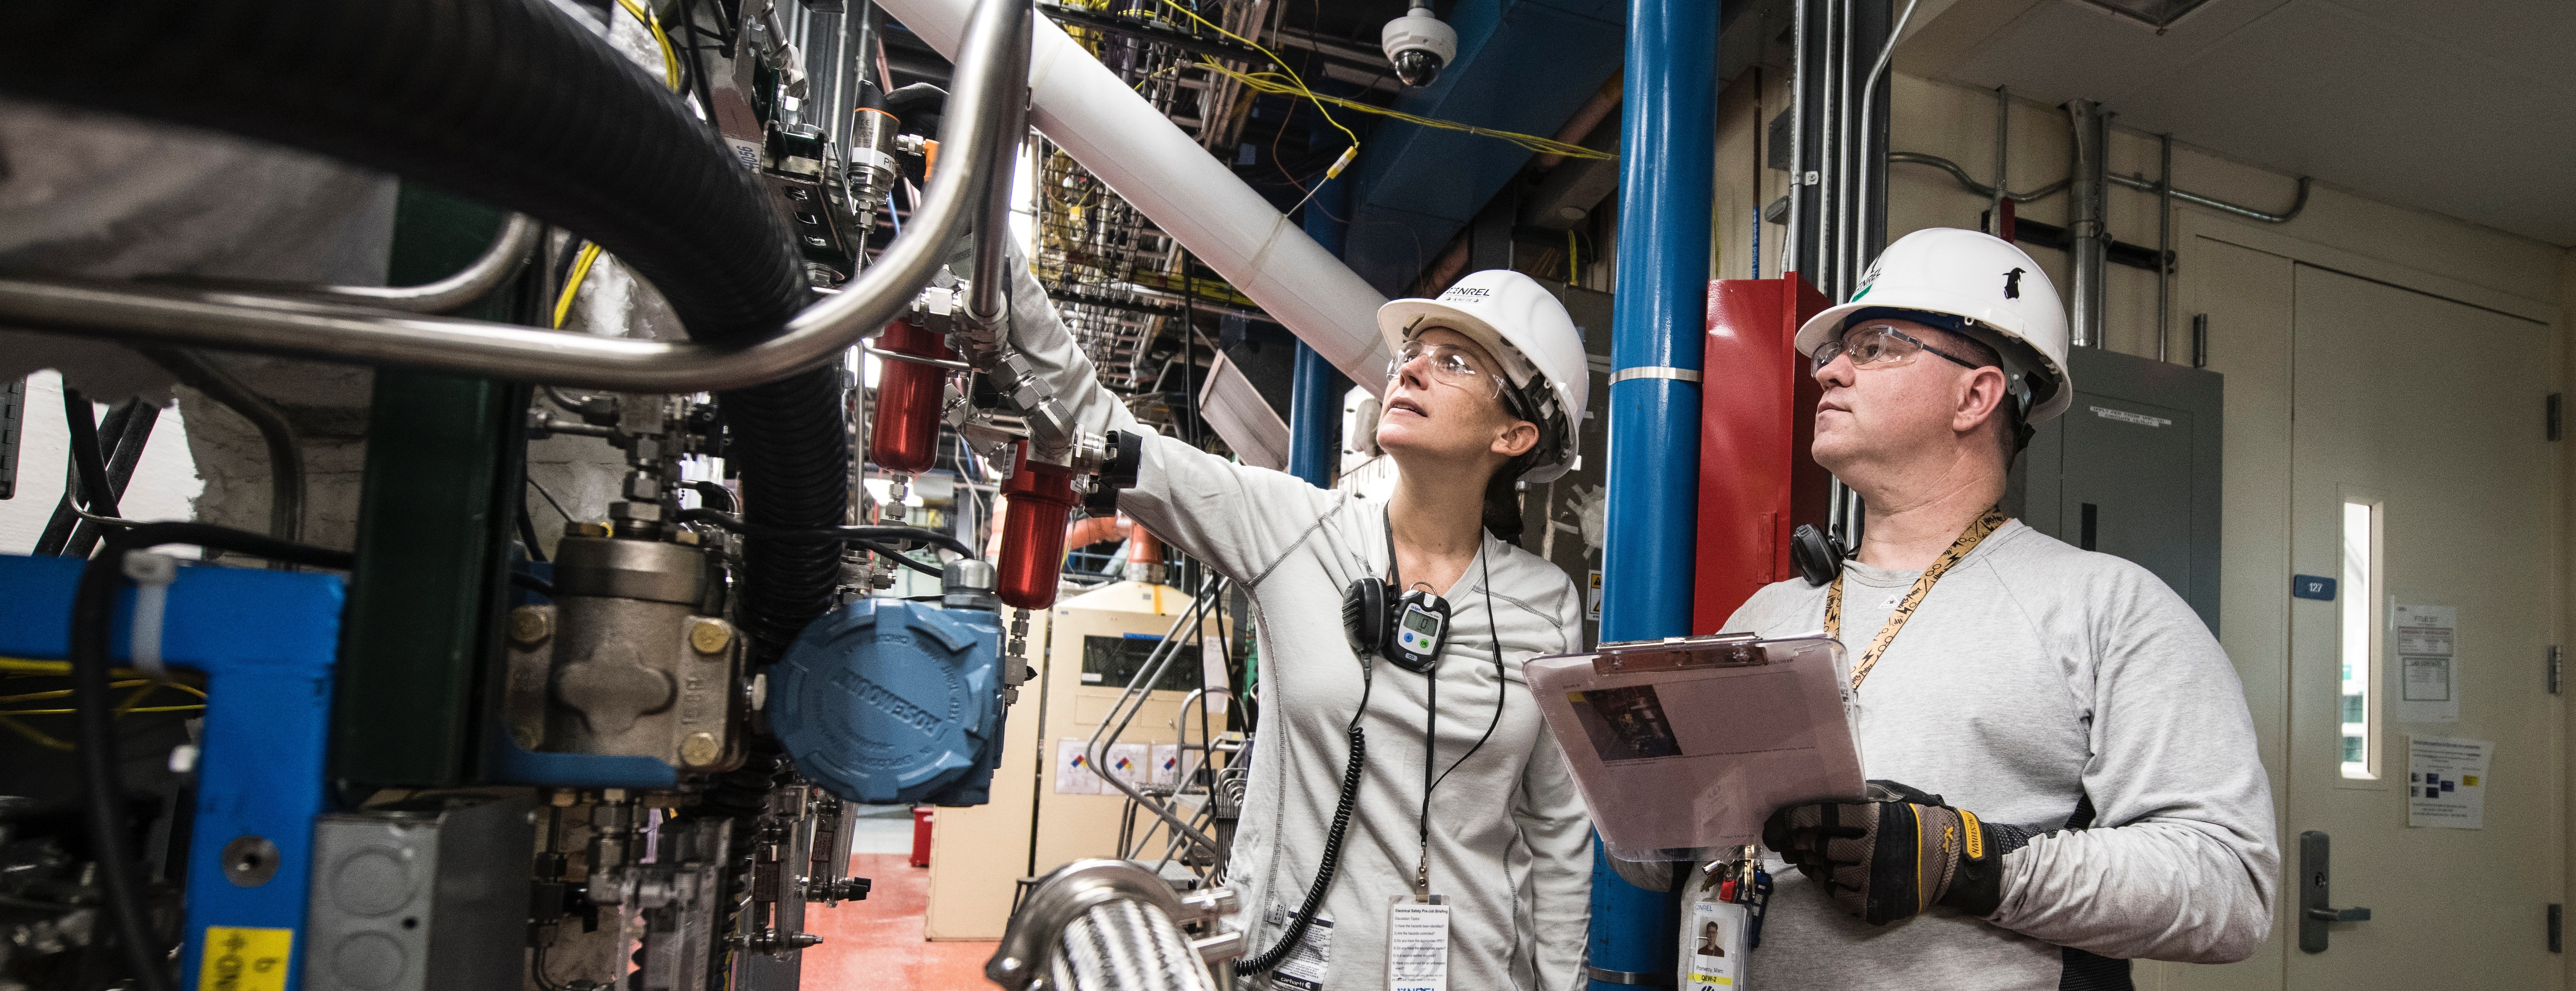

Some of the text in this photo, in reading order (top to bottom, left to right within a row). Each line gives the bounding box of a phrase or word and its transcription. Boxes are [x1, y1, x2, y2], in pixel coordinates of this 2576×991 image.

[1860, 268, 1881, 289] NREL
[1457, 288, 1490, 296] NREL
[2309, 583, 2323, 592] 127
[1906, 587, 1922, 600] Potter
[1421, 618, 1428, 629] 0
[1281, 977, 1304, 987] carhartt
